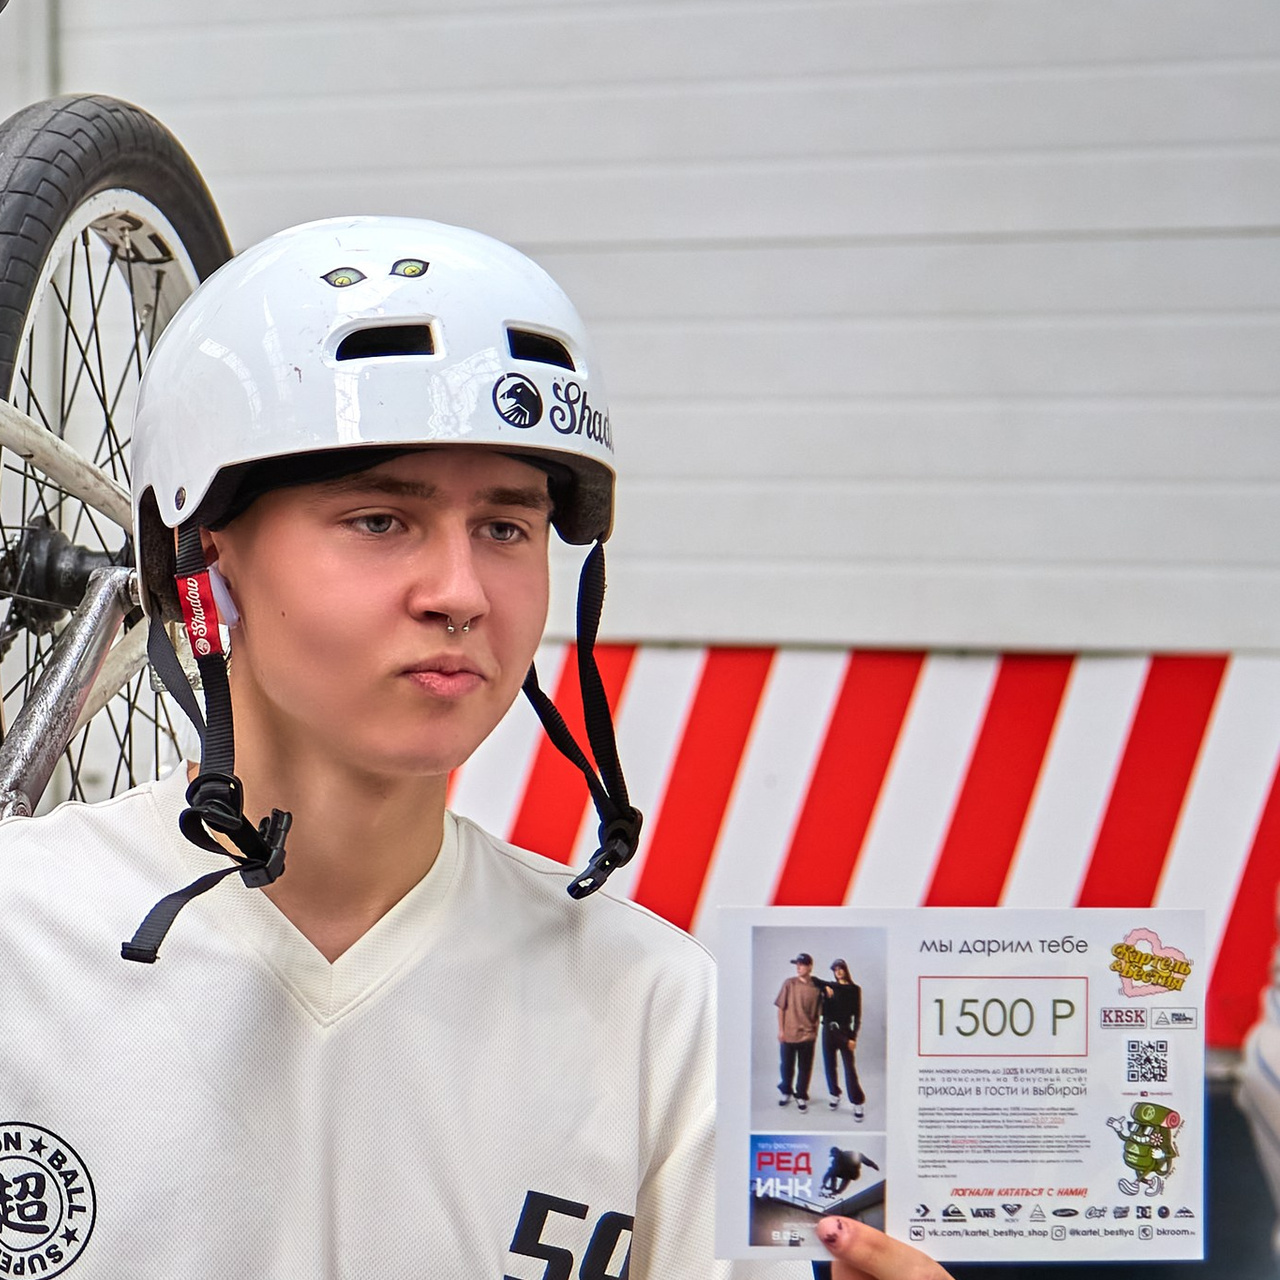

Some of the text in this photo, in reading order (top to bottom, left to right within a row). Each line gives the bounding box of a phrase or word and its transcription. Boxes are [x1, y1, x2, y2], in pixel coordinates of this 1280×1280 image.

[549, 381, 615, 455] Shad
[185, 577, 208, 637] Shadow
[919, 935, 1089, 957] мы дарим тебе
[933, 997, 1035, 1037] 1500
[1102, 1009, 1146, 1023] KRSK
[918, 1083, 1088, 1098] приходи в гости и выбирай
[756, 1151, 813, 1176] РЕД
[46, 1148, 87, 1220] BALL
[755, 1177, 813, 1198] ИНК
[950, 1187, 995, 1197] ПОГНАЛИ
[997, 1187, 1045, 1197] КАТАТЬСЯ
[1056, 1187, 1088, 1198] НАМИ!
